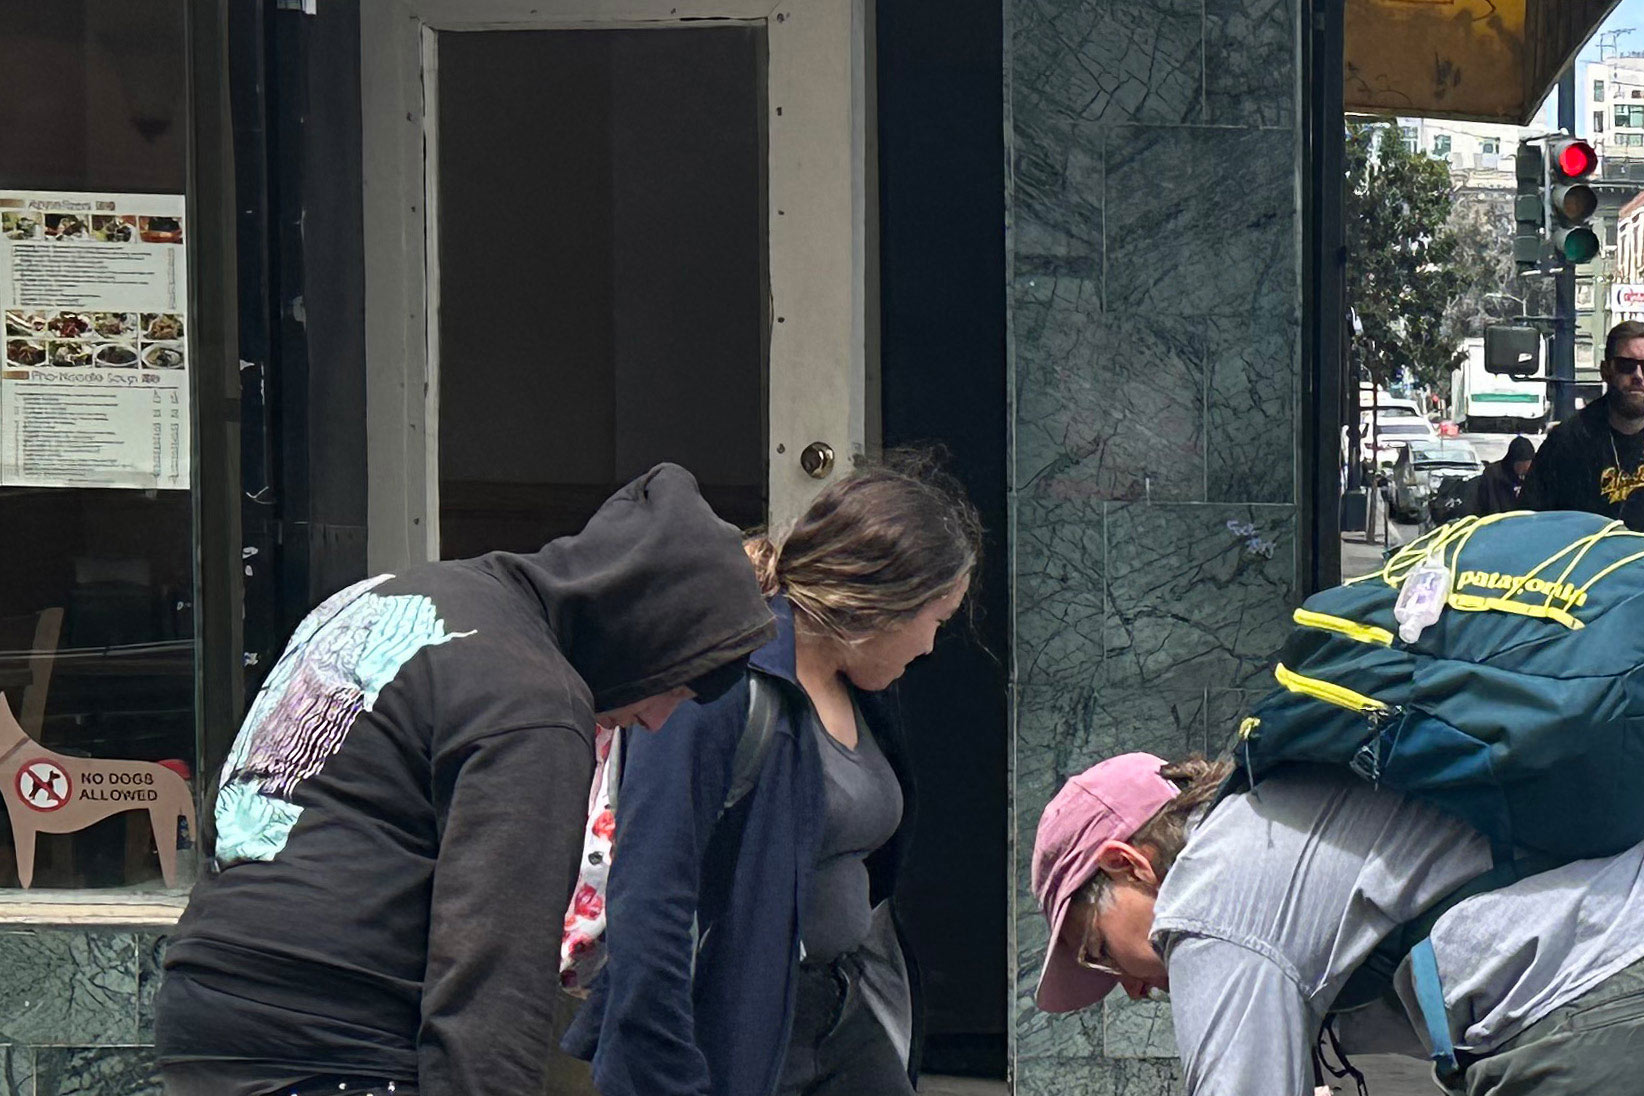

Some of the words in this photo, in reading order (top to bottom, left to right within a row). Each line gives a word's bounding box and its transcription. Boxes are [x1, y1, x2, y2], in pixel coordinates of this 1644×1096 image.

[81, 773, 104, 785] NO
[108, 773, 154, 785] DOGS
[79, 789, 158, 802] ALLOWED
